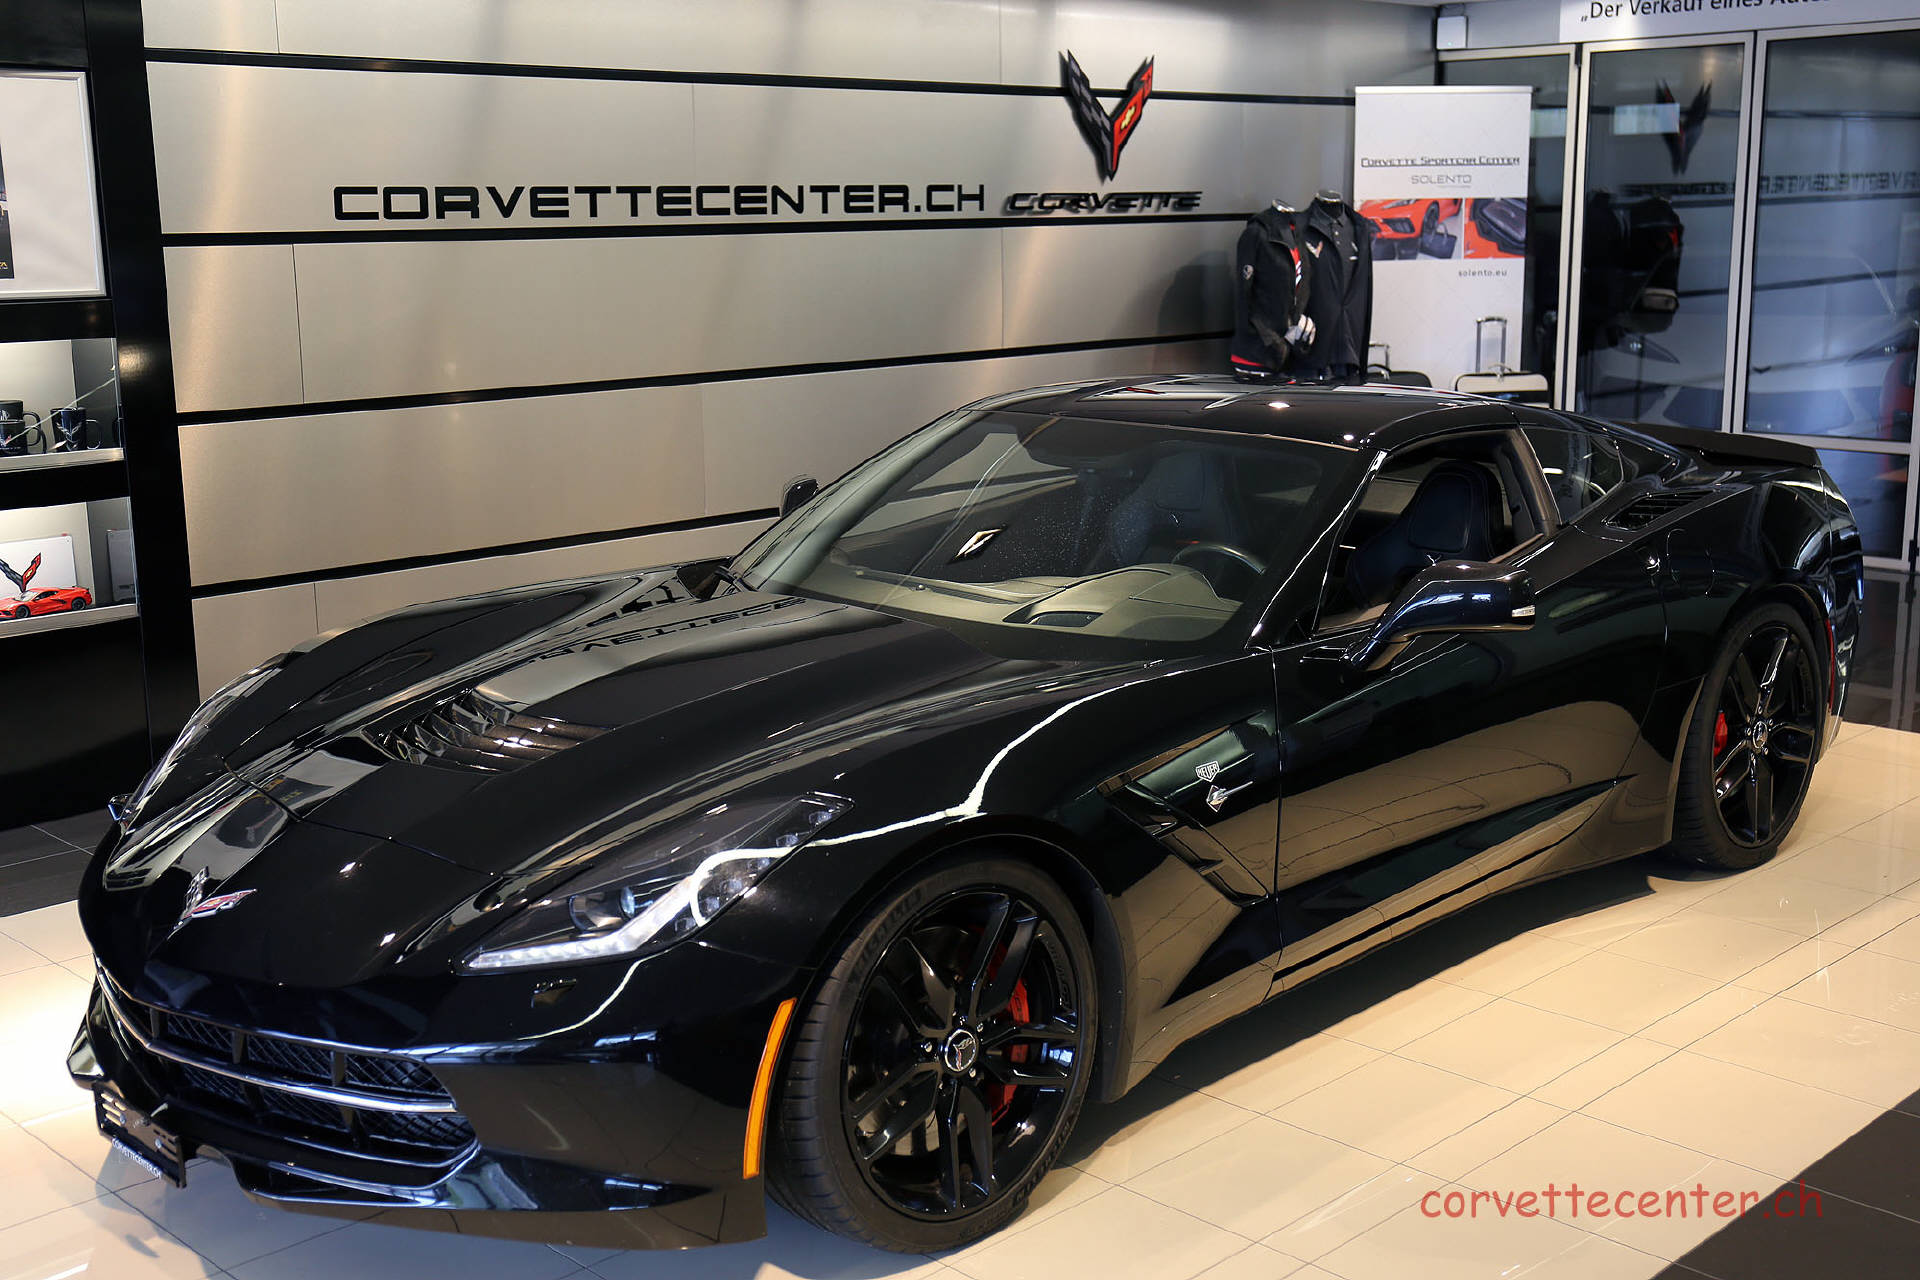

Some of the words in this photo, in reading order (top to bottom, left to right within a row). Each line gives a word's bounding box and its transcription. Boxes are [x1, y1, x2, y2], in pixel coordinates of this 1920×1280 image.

[1411, 174, 1473, 185] SOLENTO
[333, 184, 985, 221] CORVETTECENTER.CH
[1004, 191, 1203, 214] CORVETTE
[1458, 268, 1508, 277] solento.eu
